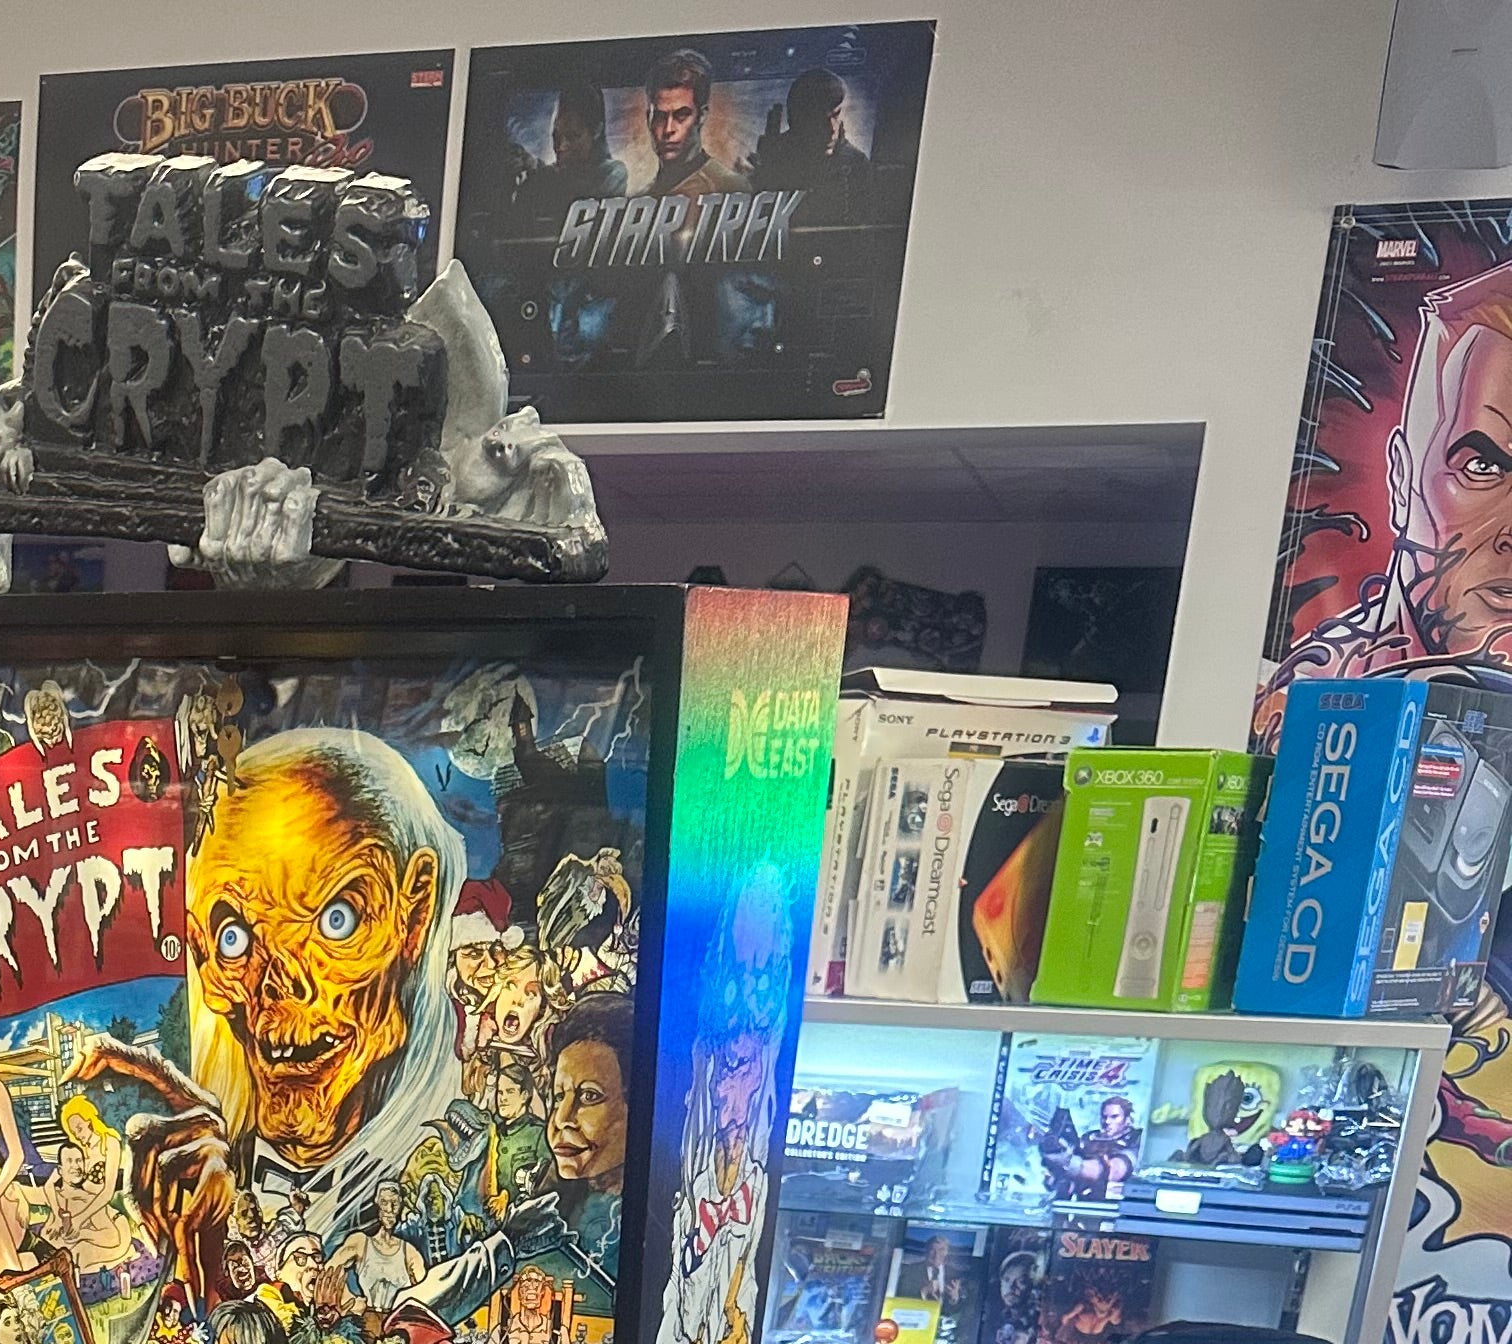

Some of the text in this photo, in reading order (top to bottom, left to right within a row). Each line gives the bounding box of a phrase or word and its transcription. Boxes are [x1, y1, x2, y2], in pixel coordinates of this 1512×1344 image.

[139, 79, 343, 153] BIG BUCK
[75, 153, 428, 288] TALES
[554, 190, 807, 268] STAR TREK
[1376, 240, 1417, 258] MARVEL
[112, 258, 326, 317] FROM THE
[34, 292, 423, 482] CRYPT
[774, 691, 821, 729] DATA
[1319, 693, 1366, 710] SEGA
[879, 714, 914, 725] SONY
[926, 728, 1072, 745] PLAYSTATION 3
[767, 737, 821, 779] EAST
[1095, 771, 1138, 785] XBOX
[1138, 770, 1164, 785] 360
[992, 794, 1019, 817] Sega
[46, 820, 100, 853] THE
[922, 768, 961, 937] Sega Dreamcast
[1284, 722, 1358, 985] SEGA CD
[1037, 1061, 1126, 1083] CRISIS 4
[1057, 1056, 1111, 1071] TIME
[786, 1118, 869, 1151] DREDGE
